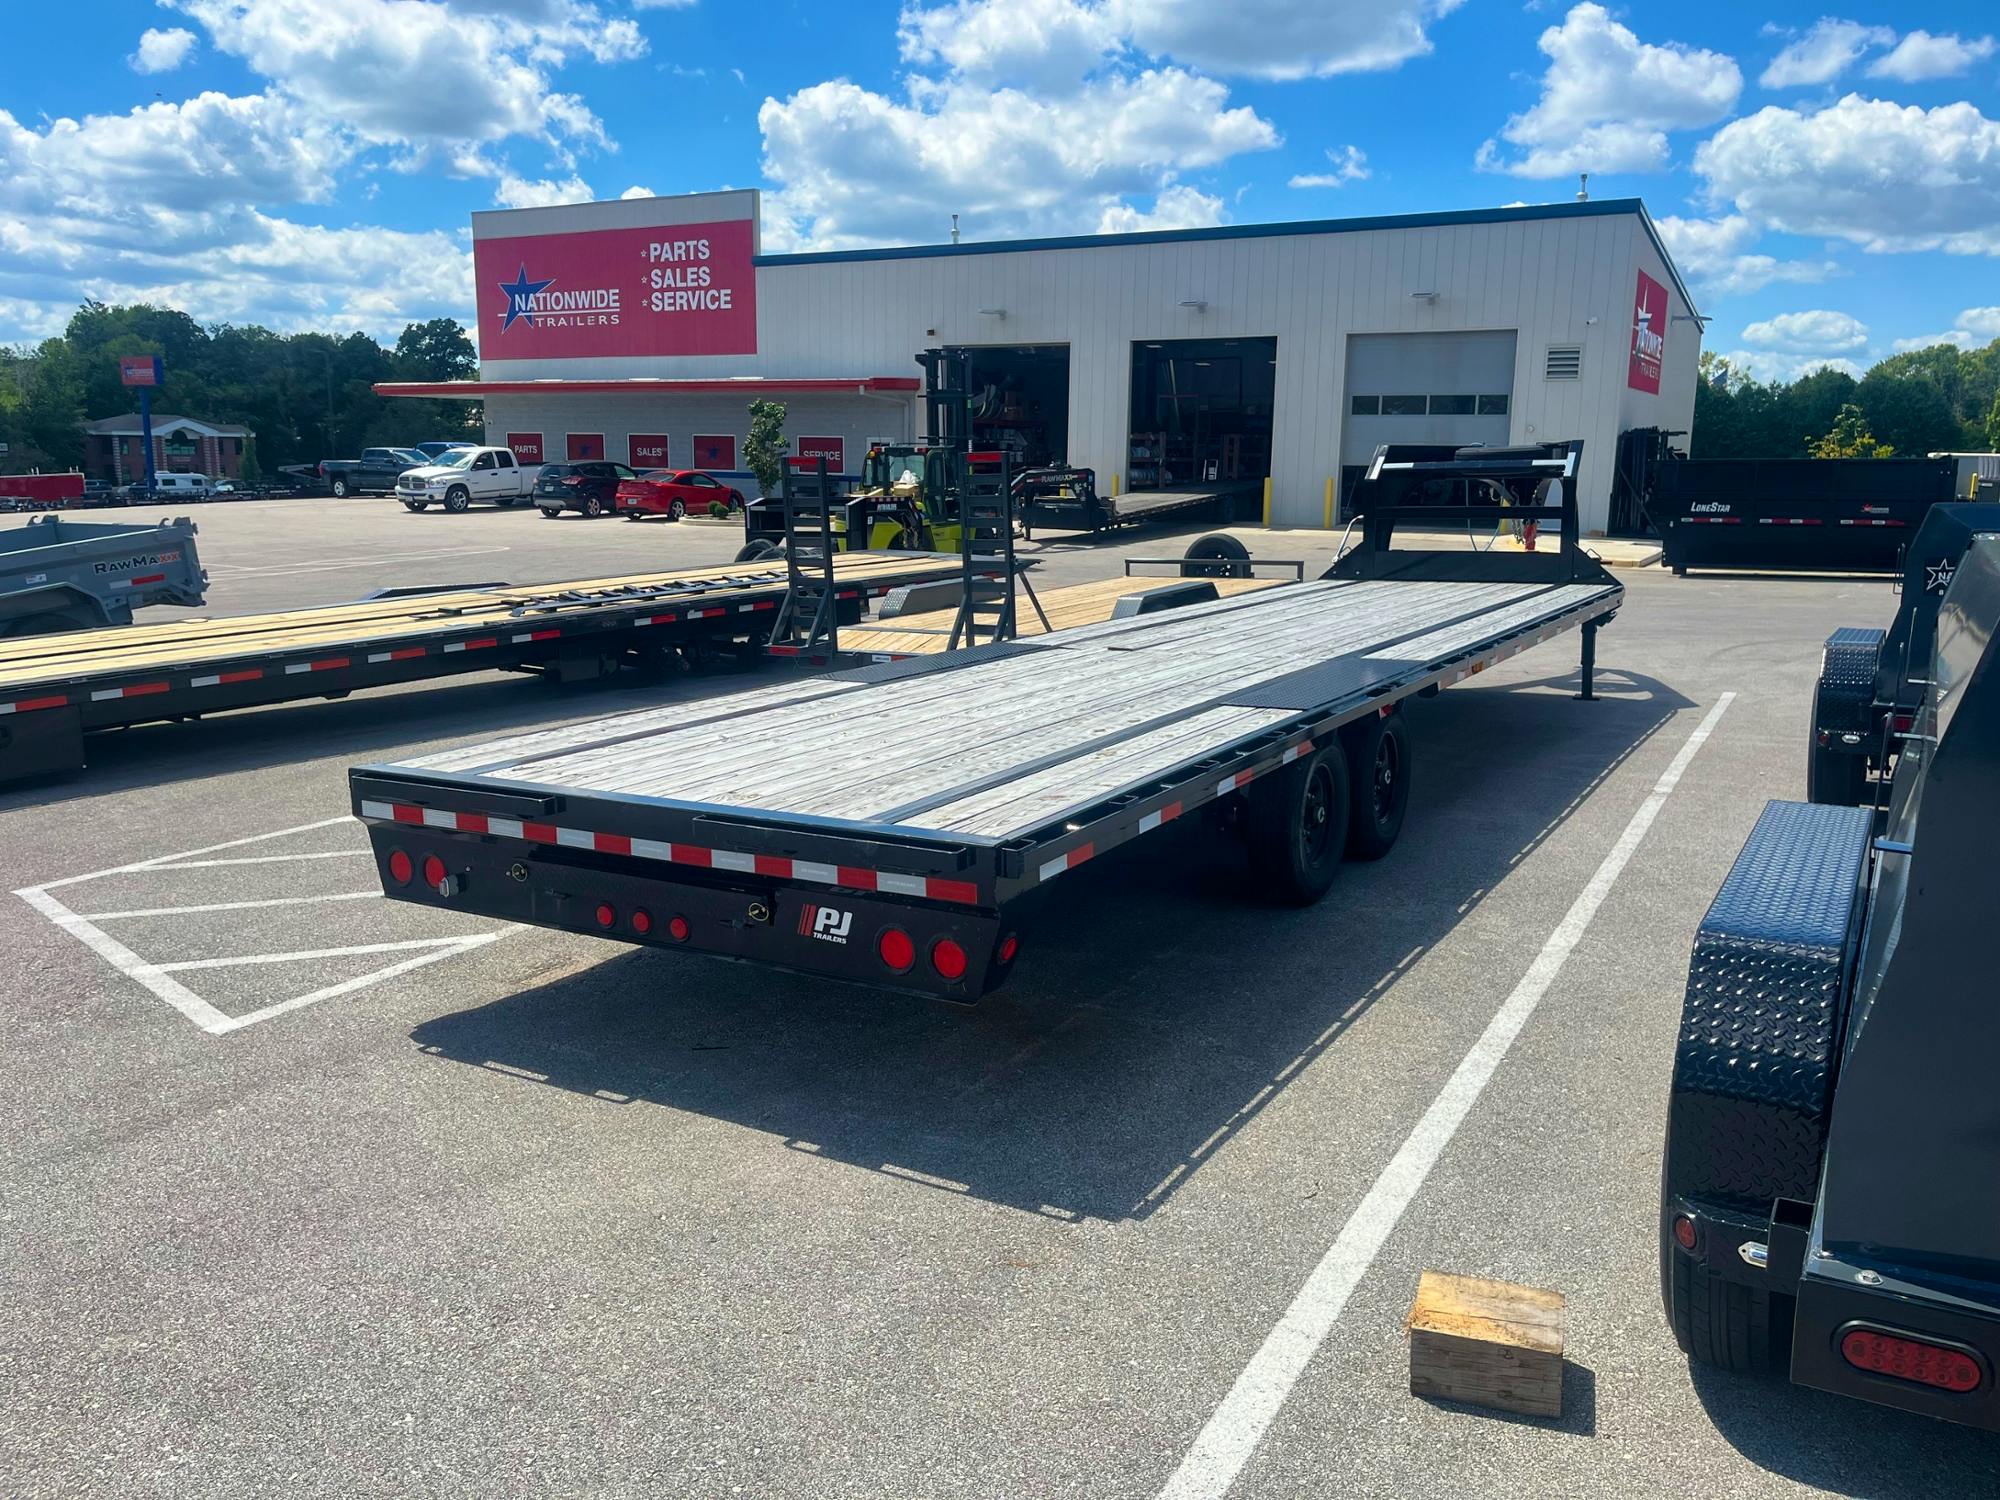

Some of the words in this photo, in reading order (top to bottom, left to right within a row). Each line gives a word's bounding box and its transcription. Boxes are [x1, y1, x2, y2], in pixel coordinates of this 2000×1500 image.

[649, 239, 710, 262] PARTS
[650, 266, 711, 289] SALES
[514, 288, 620, 312] NATIONWIDE
[651, 289, 732, 312] SERVICE
[535, 314, 620, 328] TRAILERS
[514, 444, 538, 454] PARTS
[636, 447, 663, 457] SALES
[814, 906, 853, 936] PJ
[813, 931, 848, 945] TRAILERS
